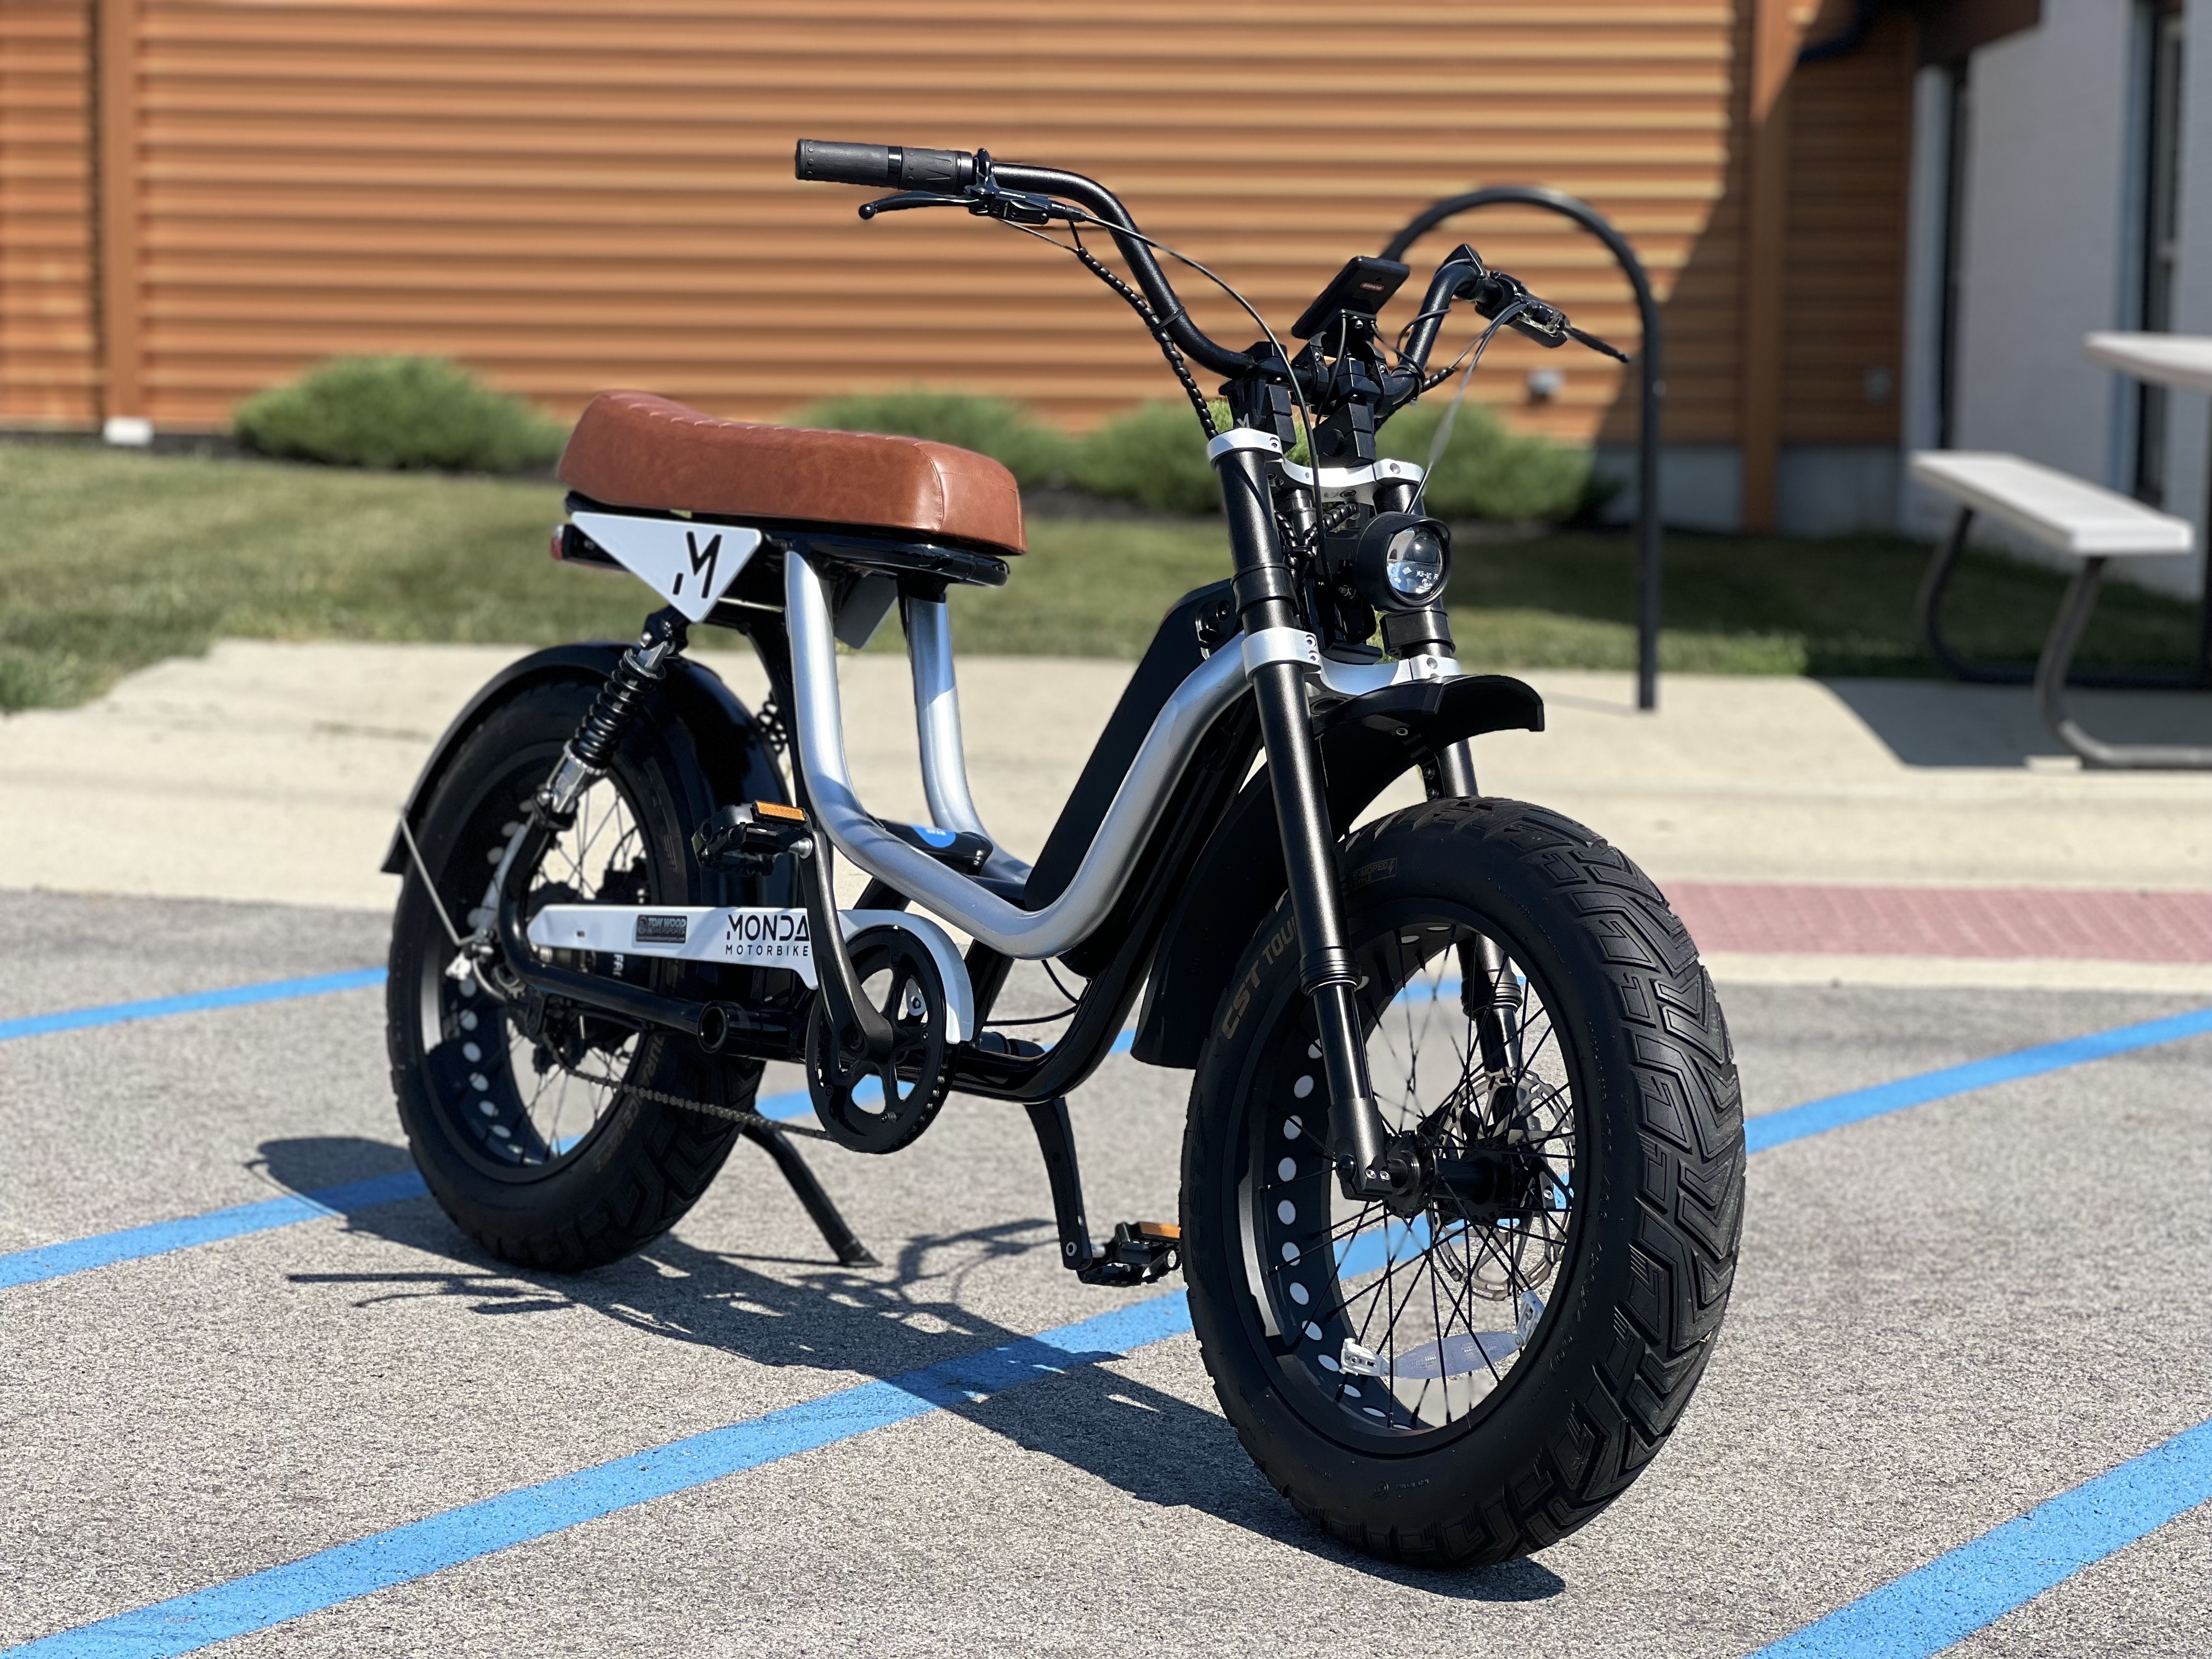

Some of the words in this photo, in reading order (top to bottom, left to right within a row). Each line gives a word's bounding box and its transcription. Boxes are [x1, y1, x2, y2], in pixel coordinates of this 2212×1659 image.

[648, 917, 663, 927] TOM
[664, 918, 686, 928] WOOD
[726, 914, 810, 941] MONDA
[725, 944, 809, 956] MOTORBIKE
[1222, 960, 1261, 1040] CST
[1262, 915, 1297, 966] TOU
